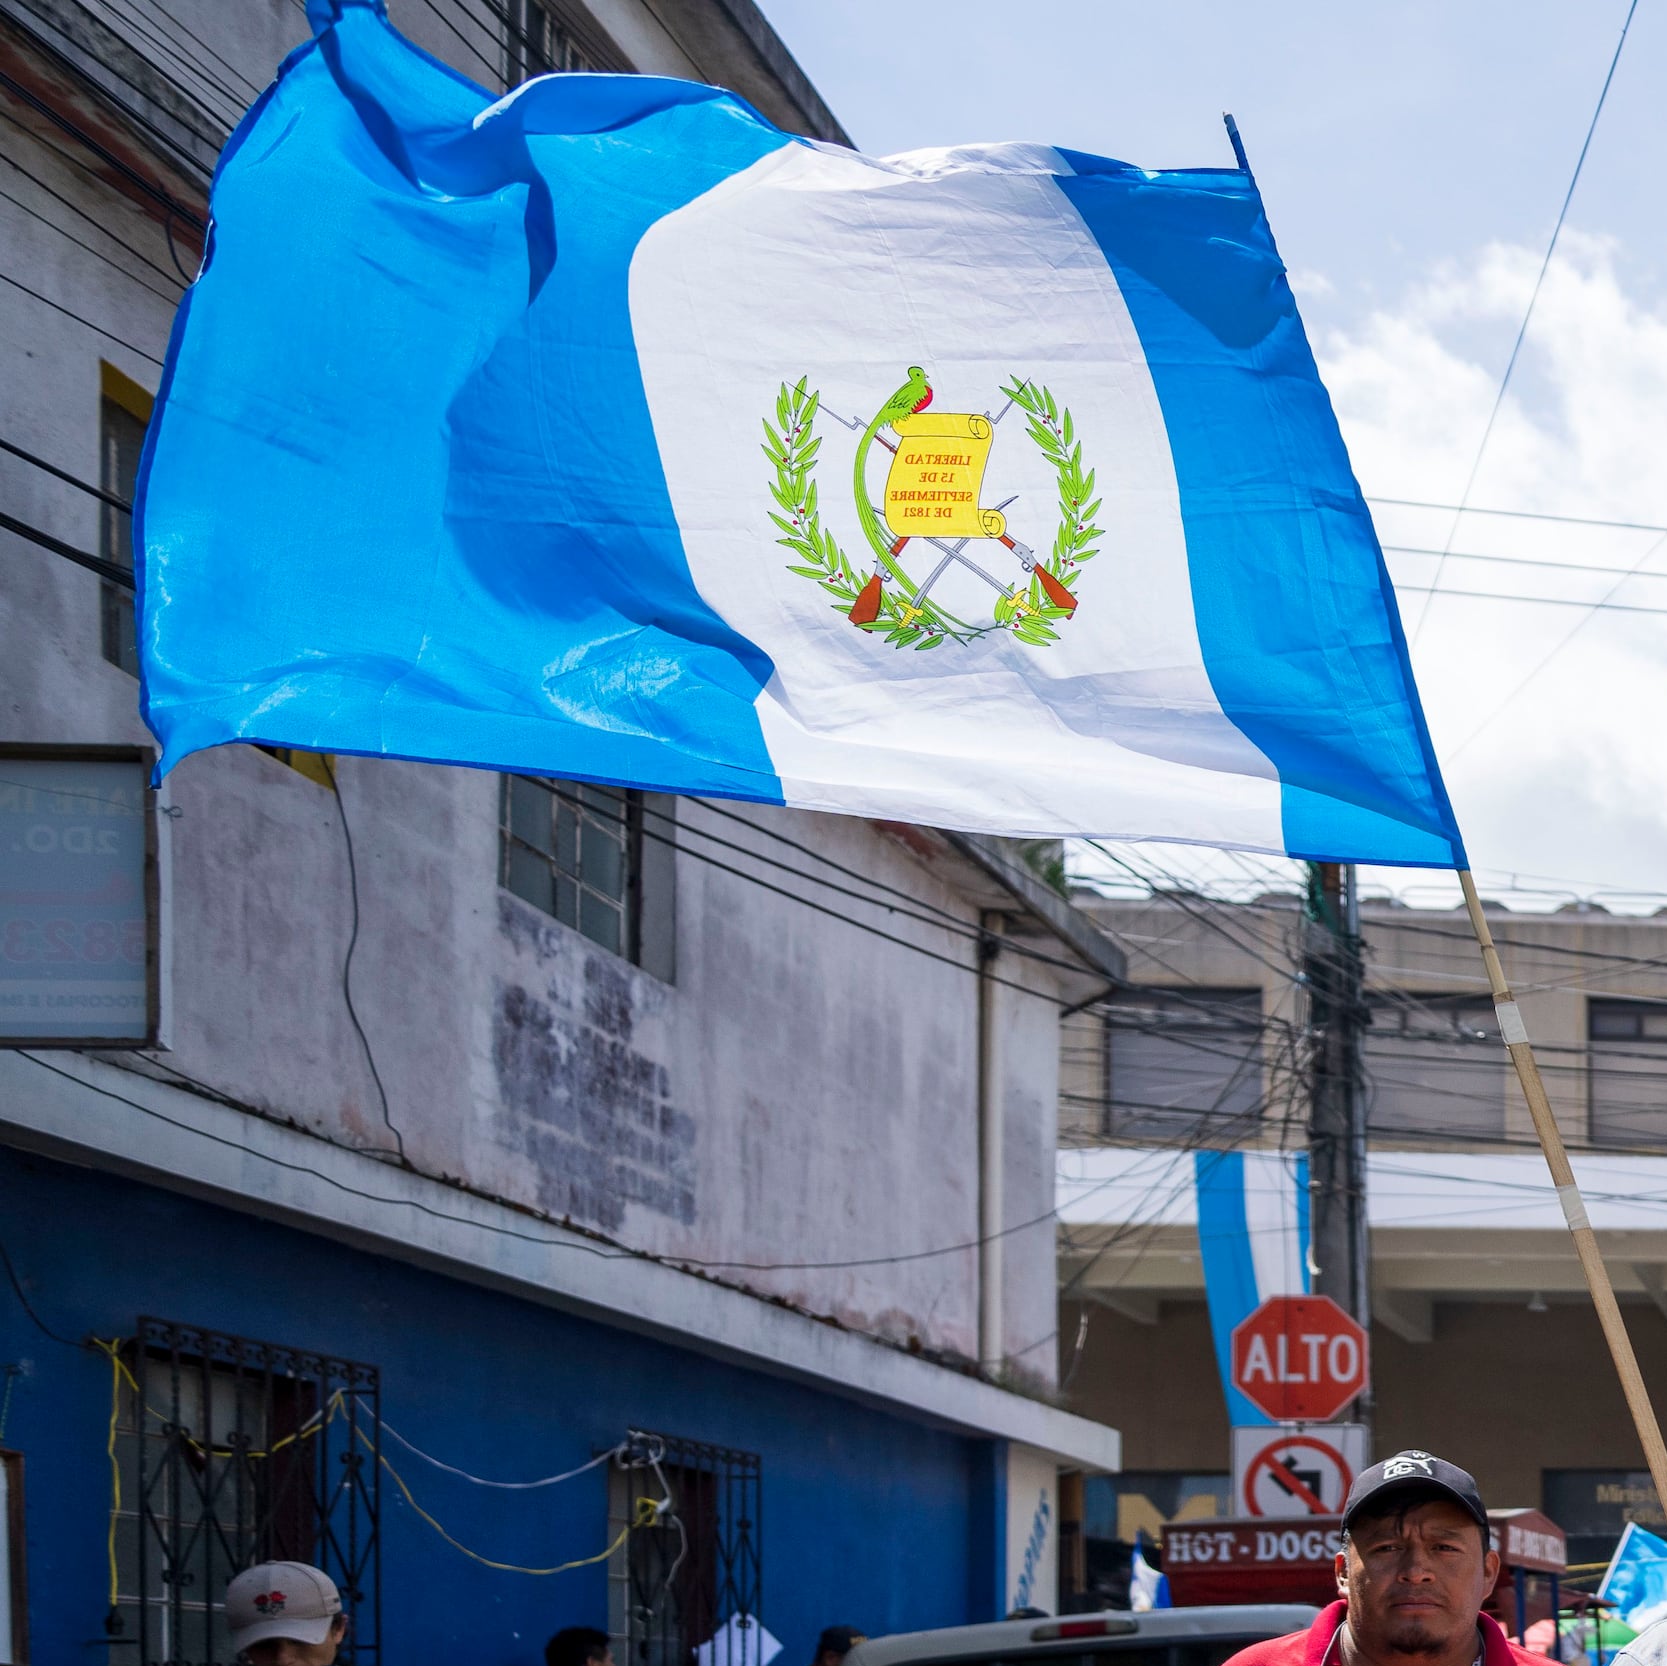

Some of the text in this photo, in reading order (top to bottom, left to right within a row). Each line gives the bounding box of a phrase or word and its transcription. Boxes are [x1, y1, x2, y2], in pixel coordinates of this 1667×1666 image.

[1242, 1333, 1360, 1383] ALTO
[1167, 1530, 1236, 1563] HOT
[1255, 1530, 1344, 1562] DOGS
